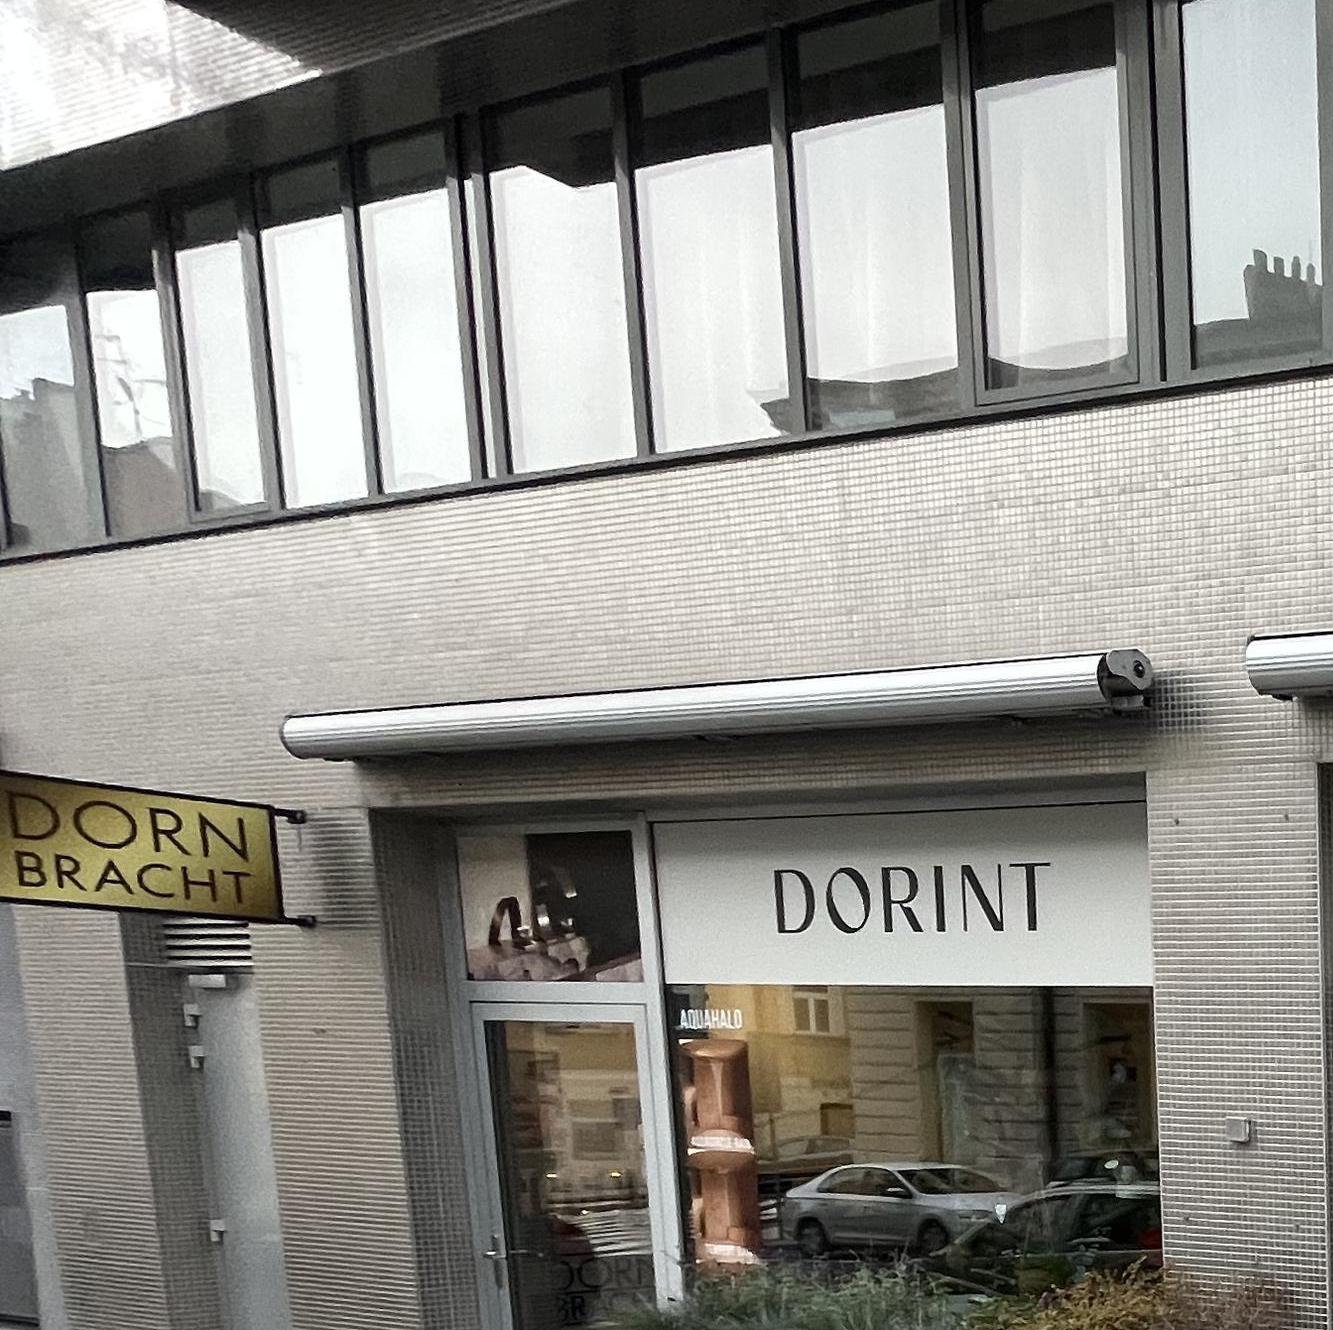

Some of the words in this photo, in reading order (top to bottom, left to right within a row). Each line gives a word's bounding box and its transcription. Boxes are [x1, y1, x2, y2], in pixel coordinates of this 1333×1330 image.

[7, 790, 250, 864] DORN
[14, 850, 252, 905] BRACHT
[773, 861, 1052, 935] DORINT
[679, 1007, 743, 1031] AQUAHALO
